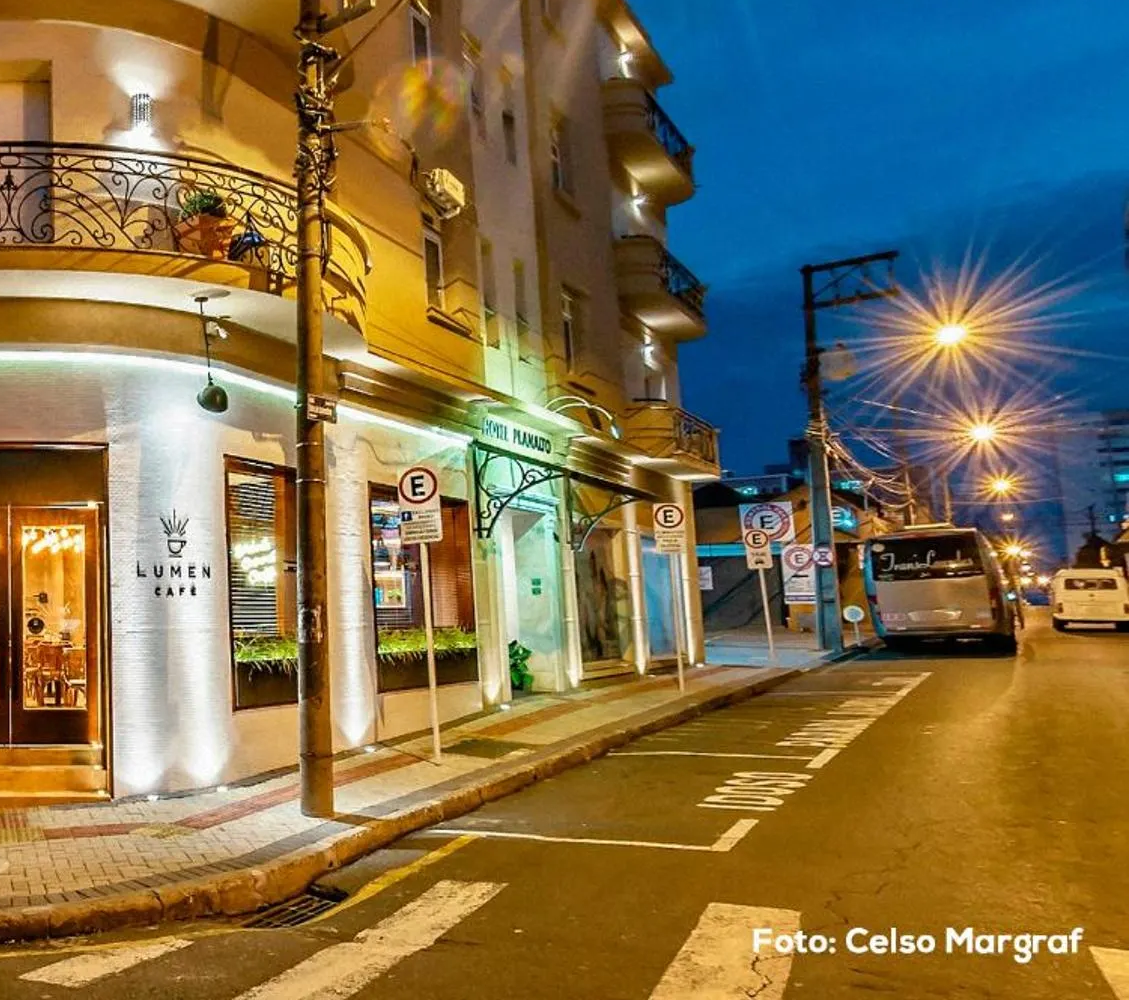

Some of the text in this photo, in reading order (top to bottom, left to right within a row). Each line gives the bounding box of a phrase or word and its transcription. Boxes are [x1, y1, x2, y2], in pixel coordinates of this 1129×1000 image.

[410, 475, 425, 496] E
[663, 509, 674, 523] E
[752, 533, 762, 545] E
[794, 553, 804, 564] E
[136, 561, 211, 579] LUMEN
[696, 771, 813, 811] IDOSO
